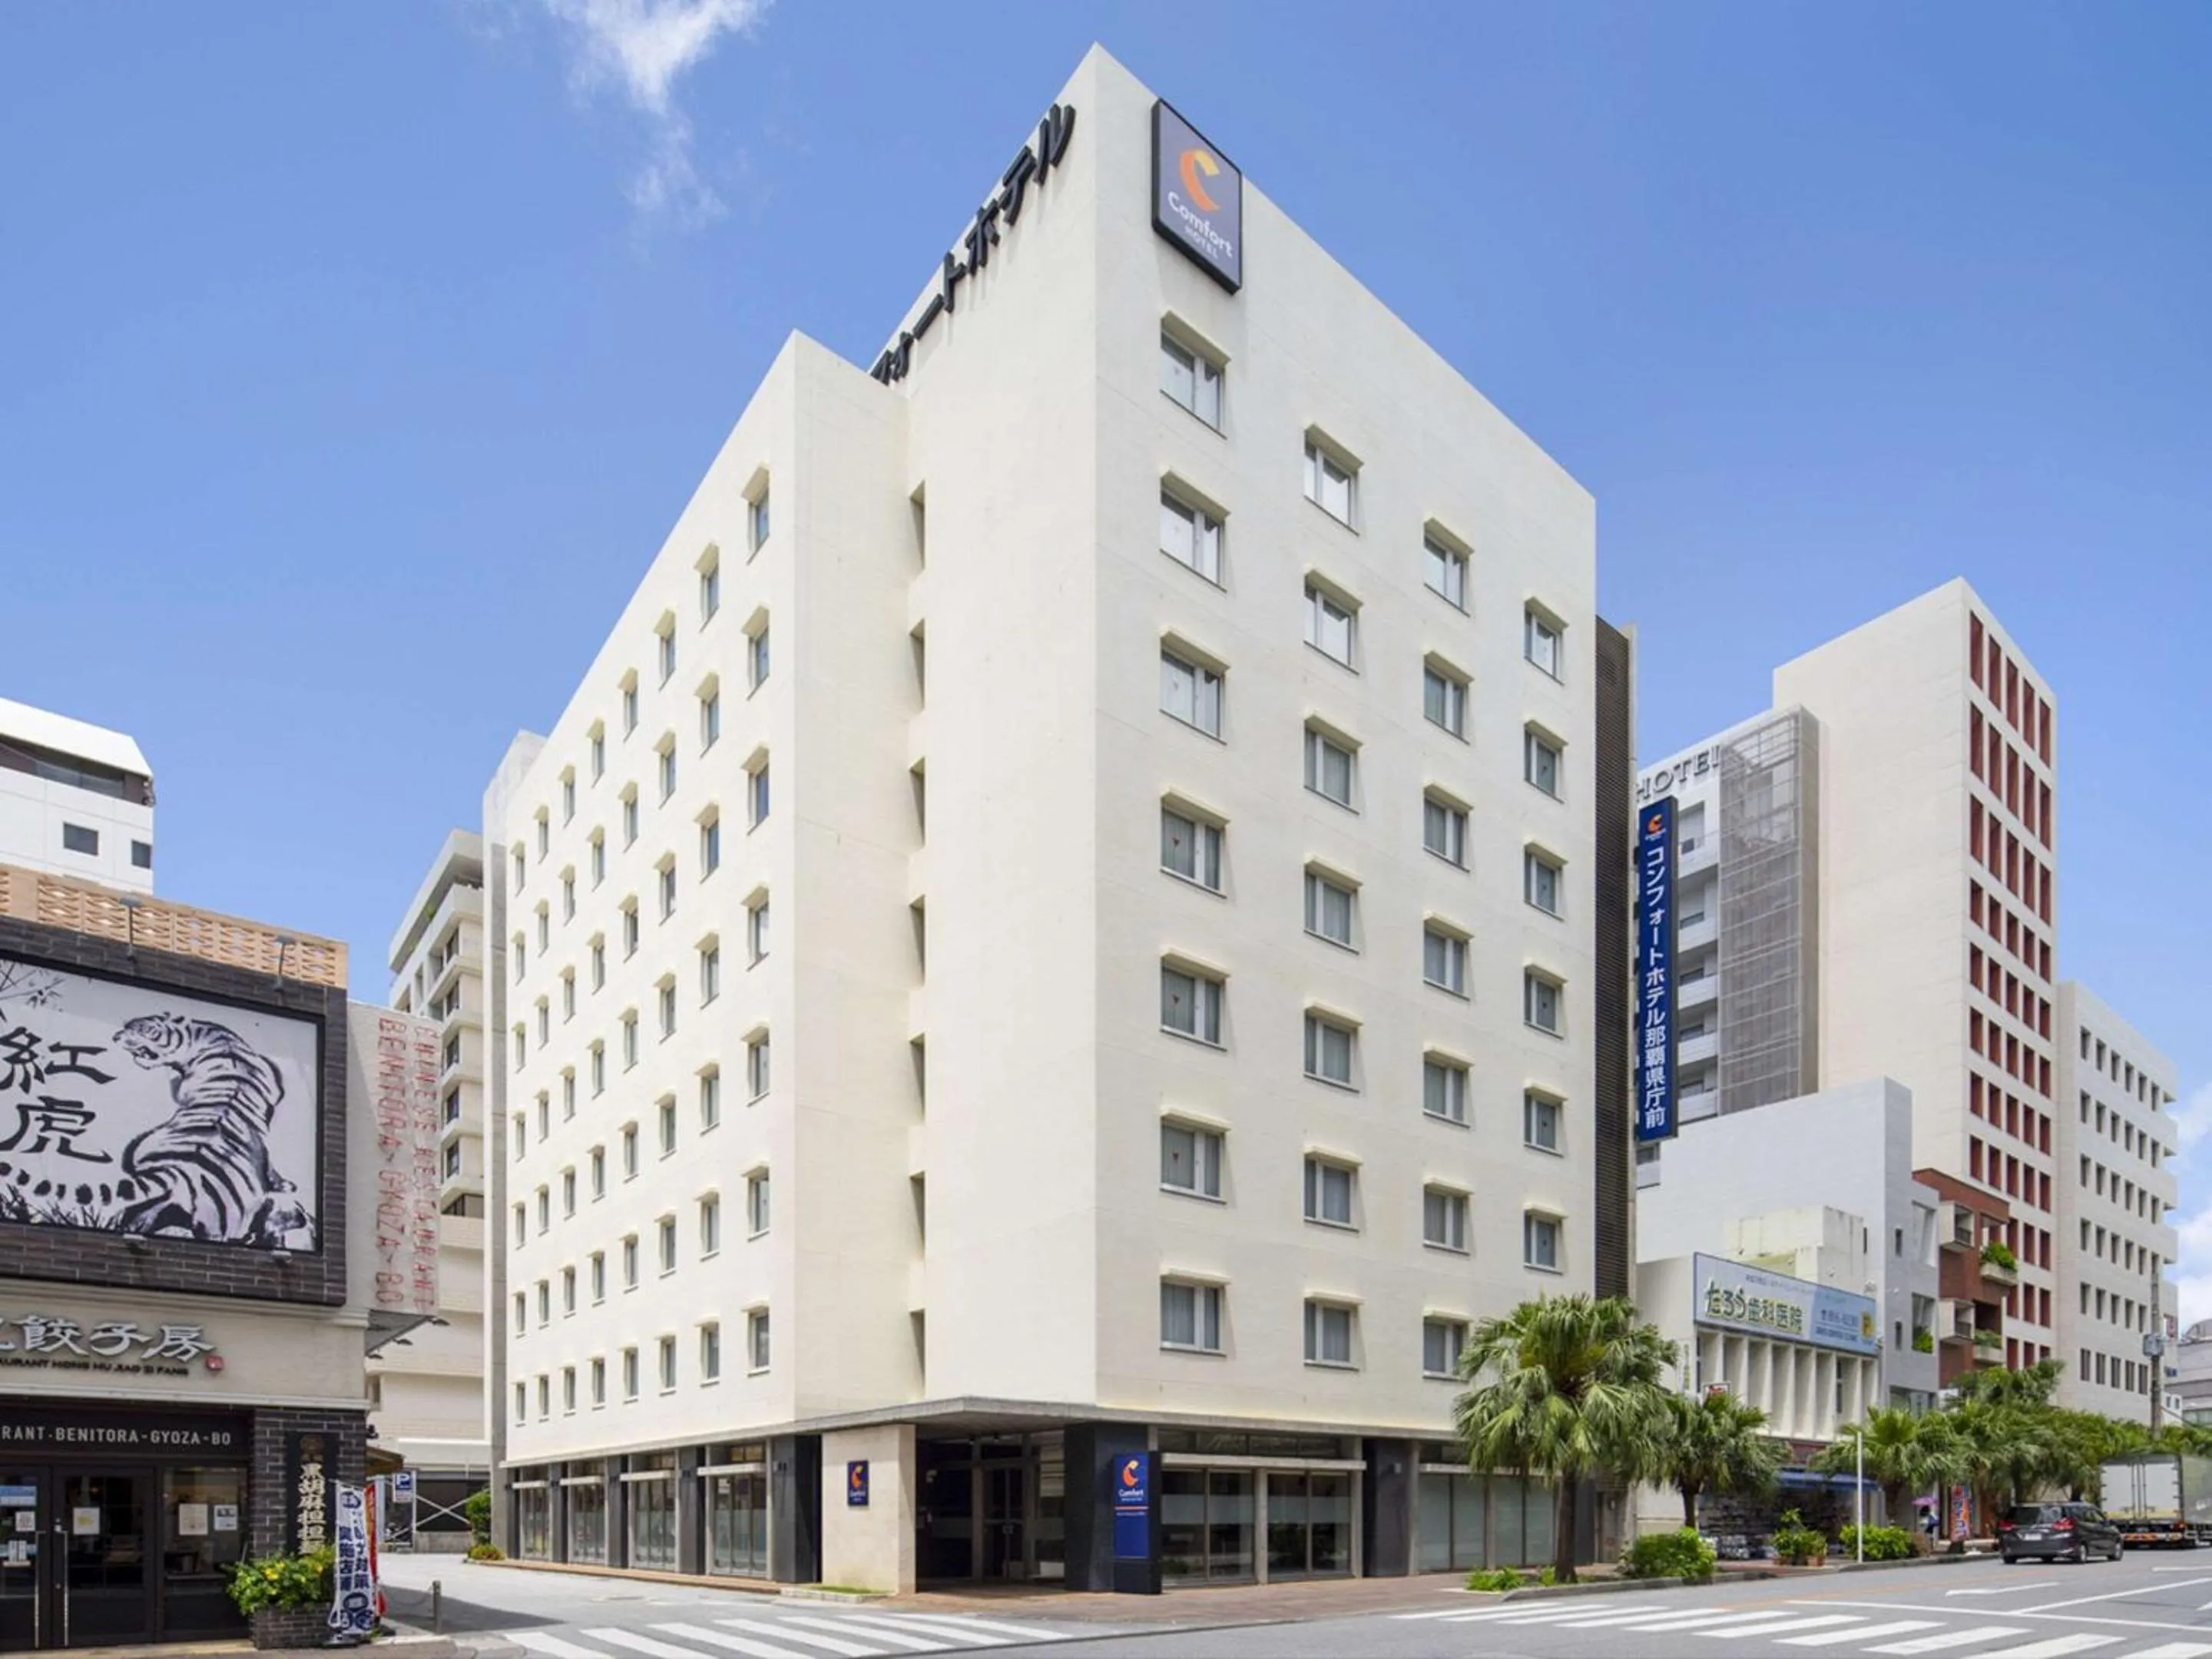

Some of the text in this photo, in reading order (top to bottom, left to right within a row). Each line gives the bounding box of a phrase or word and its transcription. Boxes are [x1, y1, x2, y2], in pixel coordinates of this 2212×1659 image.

[1167, 190, 1233, 258] Comfort
[1184, 224, 1218, 260] HOTEL
[1644, 846, 1667, 1130] コンフォートホテル那覇県庁前
[1704, 1279, 1803, 1334] たろう歯科医院
[396, 1474, 410, 1486] P
